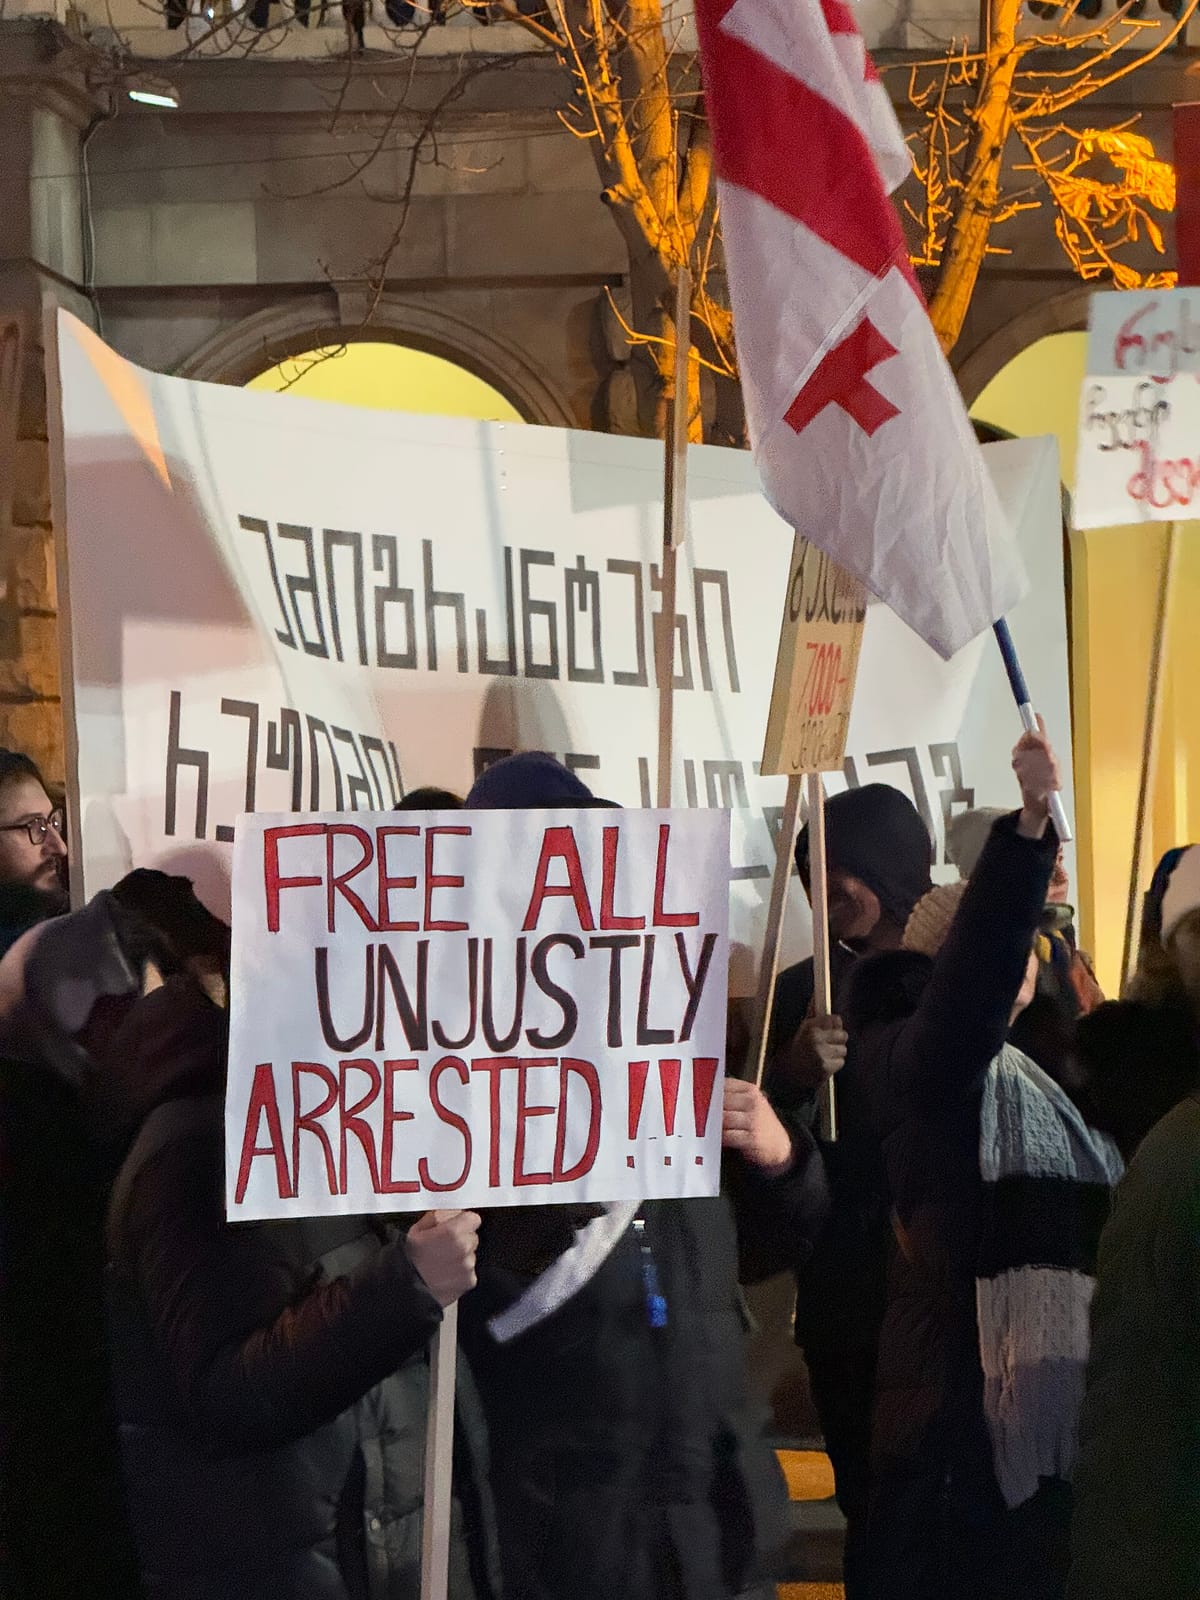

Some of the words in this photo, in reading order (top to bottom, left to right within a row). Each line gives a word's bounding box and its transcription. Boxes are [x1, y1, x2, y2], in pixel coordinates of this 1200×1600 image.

[238, 513, 741, 694] ემიგრანტები
[263, 823, 473, 933] FREE
[521, 823, 701, 932] ALL
[314, 932, 720, 1053] UNJUSTLY
[234, 1055, 602, 1205] ARRESTED
